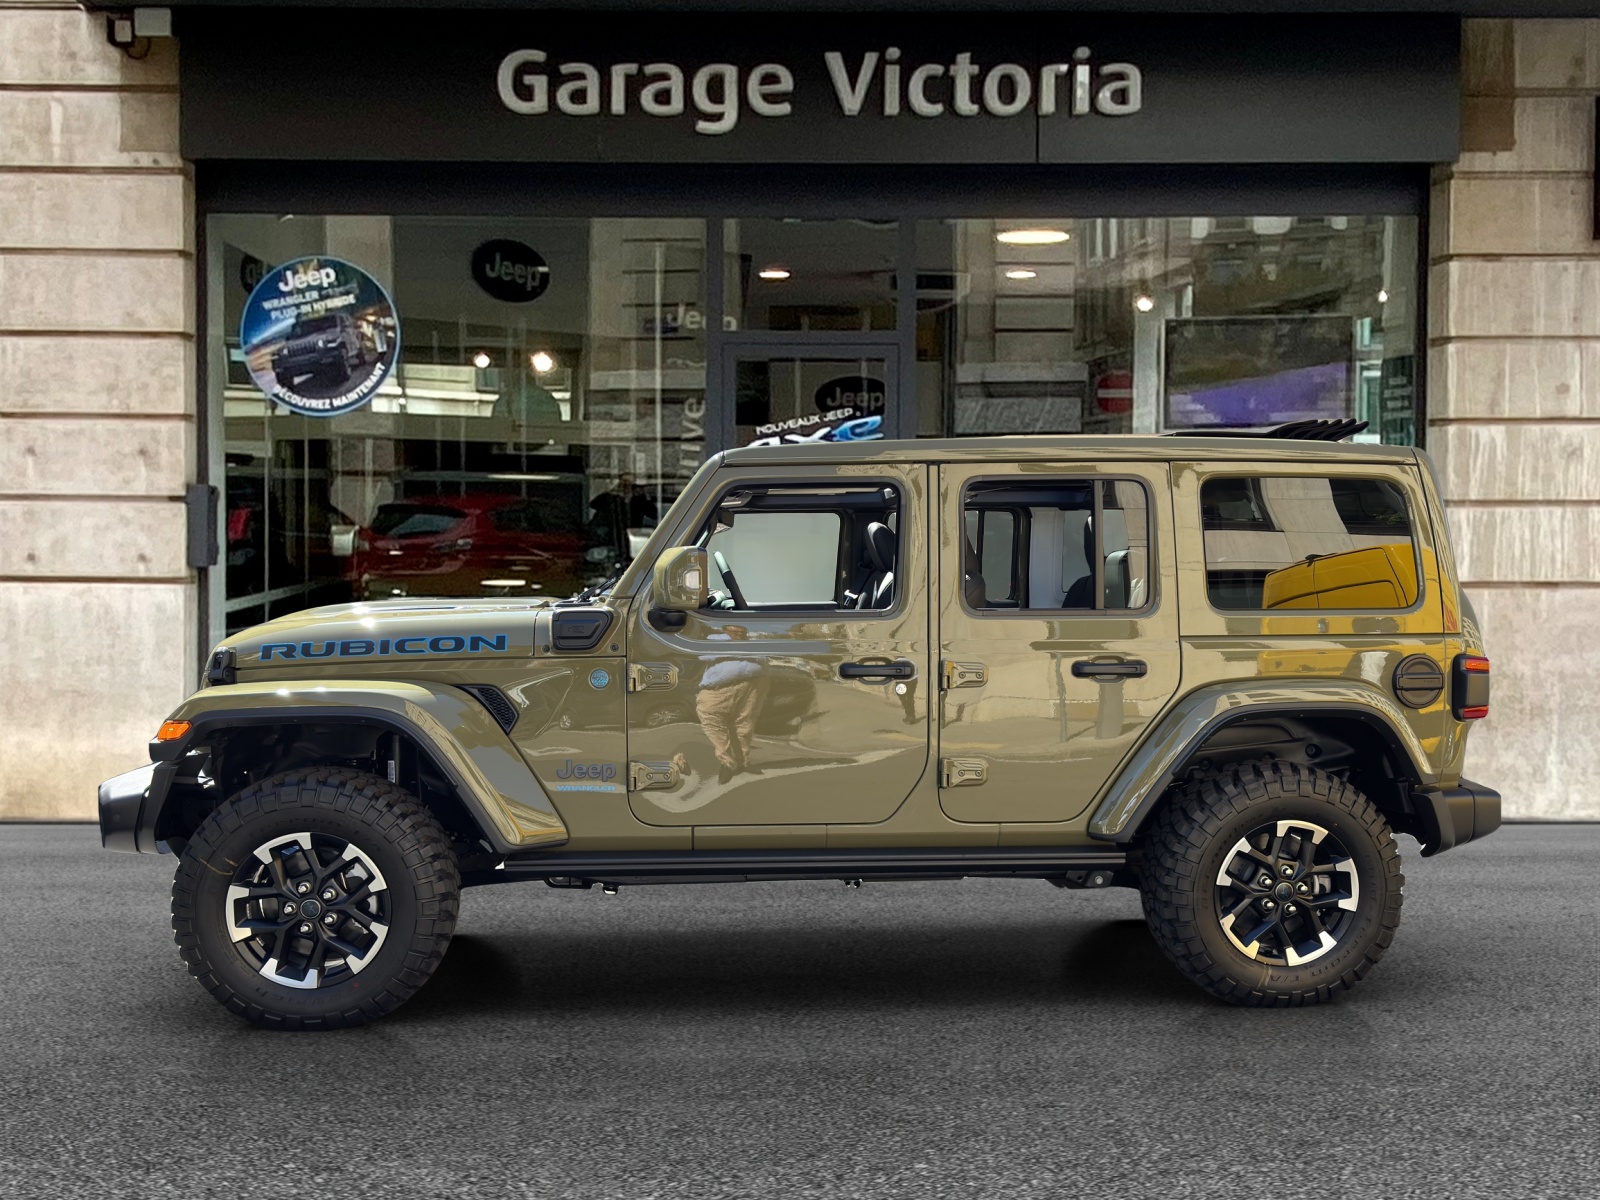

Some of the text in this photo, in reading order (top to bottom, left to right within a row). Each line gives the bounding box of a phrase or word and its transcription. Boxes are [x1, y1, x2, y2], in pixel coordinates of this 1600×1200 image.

[498, 46, 1143, 135] Garage Victoria
[278, 266, 336, 292] Jeep
[485, 251, 541, 292] Jeep
[262, 290, 319, 310] WRANGLER
[666, 303, 738, 331] Jep
[826, 387, 883, 411] Jeep
[755, 407, 853, 435] NOUVEAUX JEEP
[259, 634, 509, 661] RUBICON
[556, 758, 617, 782] Jeep
